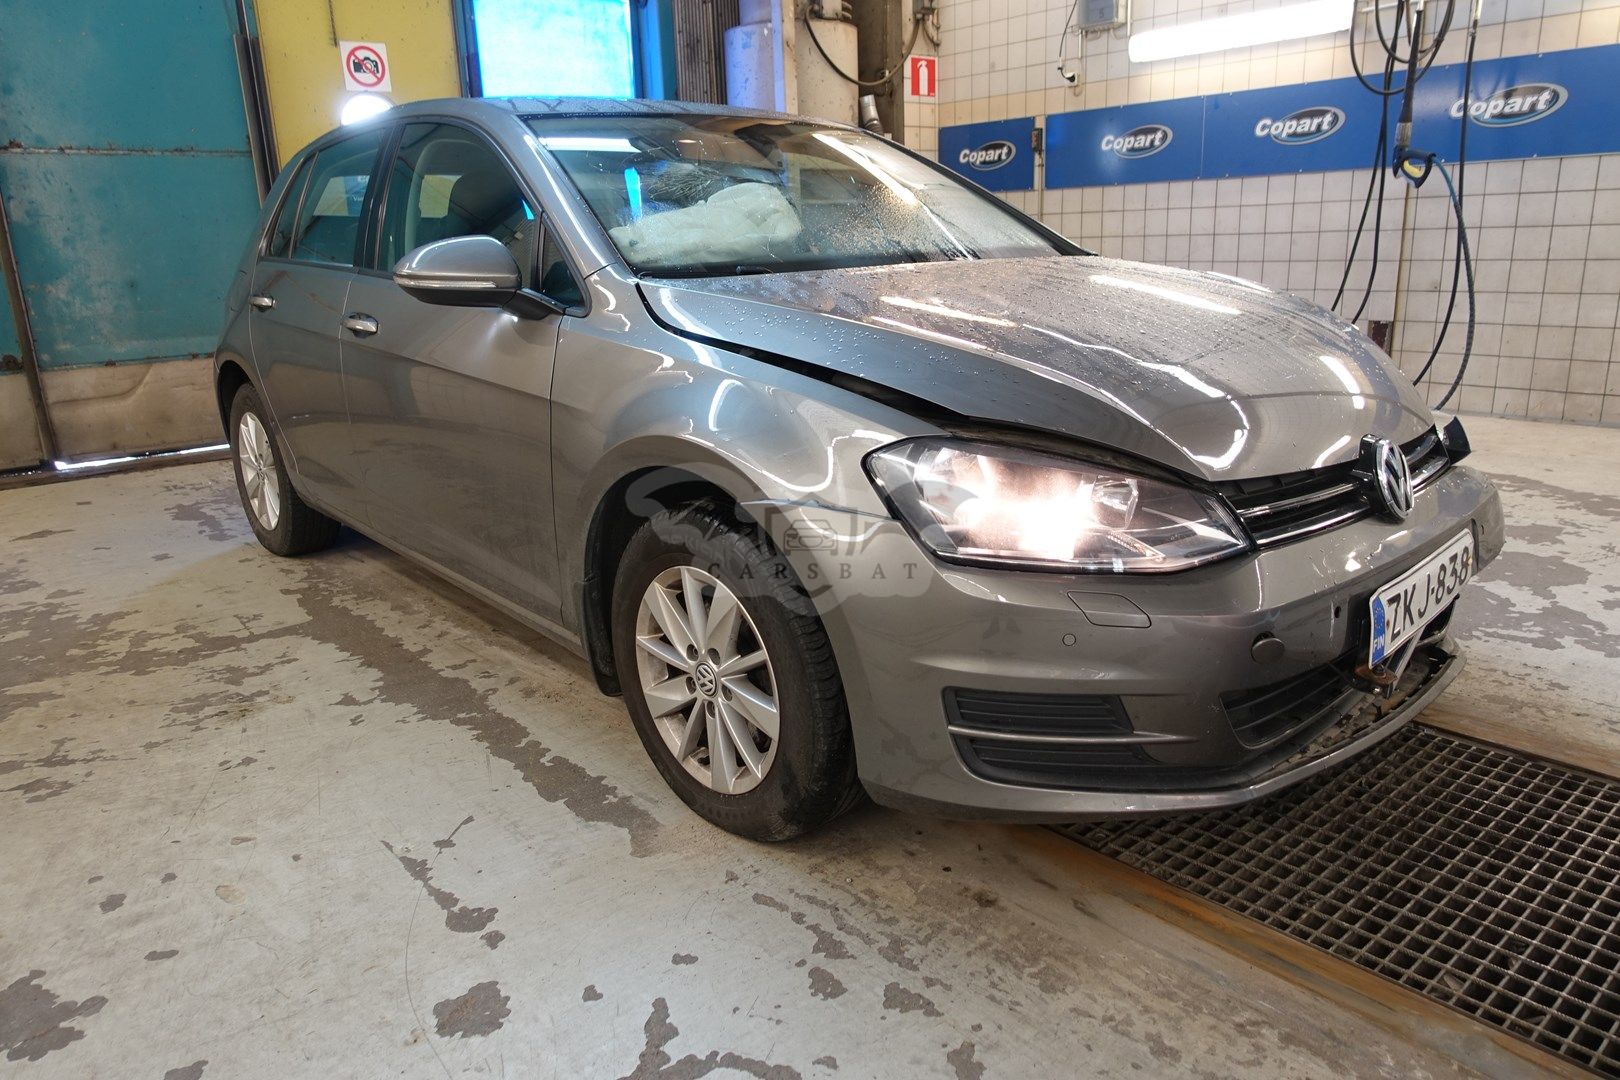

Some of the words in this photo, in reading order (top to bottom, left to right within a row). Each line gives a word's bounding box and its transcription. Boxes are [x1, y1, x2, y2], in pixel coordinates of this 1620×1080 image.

[1449, 88, 1553, 120] Copart
[1255, 110, 1335, 138] Copart
[1101, 127, 1164, 153] Copart
[959, 145, 1009, 165] Copart
[1387, 546, 1470, 643] ZKJ-838
[1373, 635, 1385, 651] FIN
